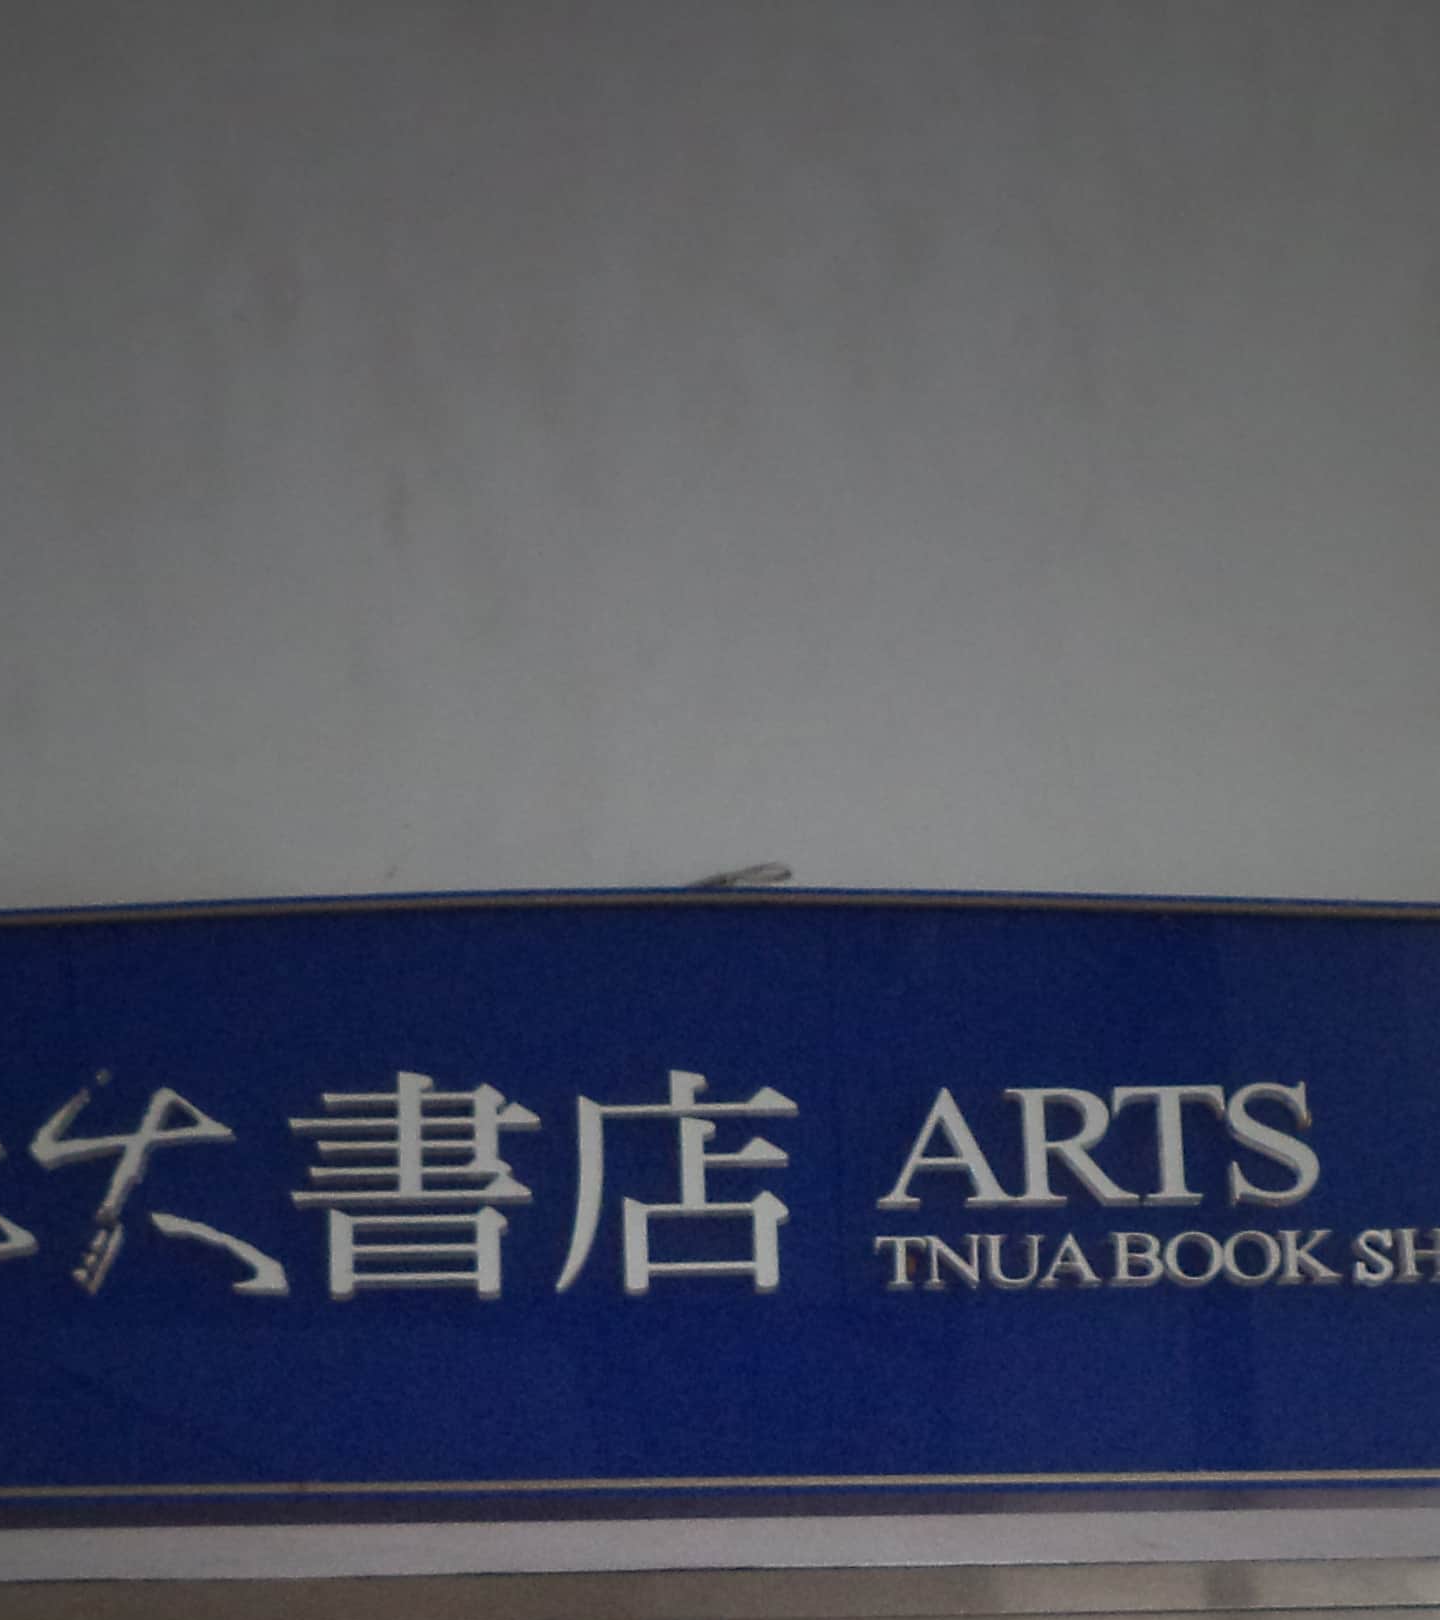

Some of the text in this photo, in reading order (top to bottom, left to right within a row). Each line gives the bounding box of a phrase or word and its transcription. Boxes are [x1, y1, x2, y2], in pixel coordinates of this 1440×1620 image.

[876, 1082, 1321, 1208] ARTS
[874, 1234, 1101, 1289] TNUA
[1105, 1229, 1342, 1287] BOOK
